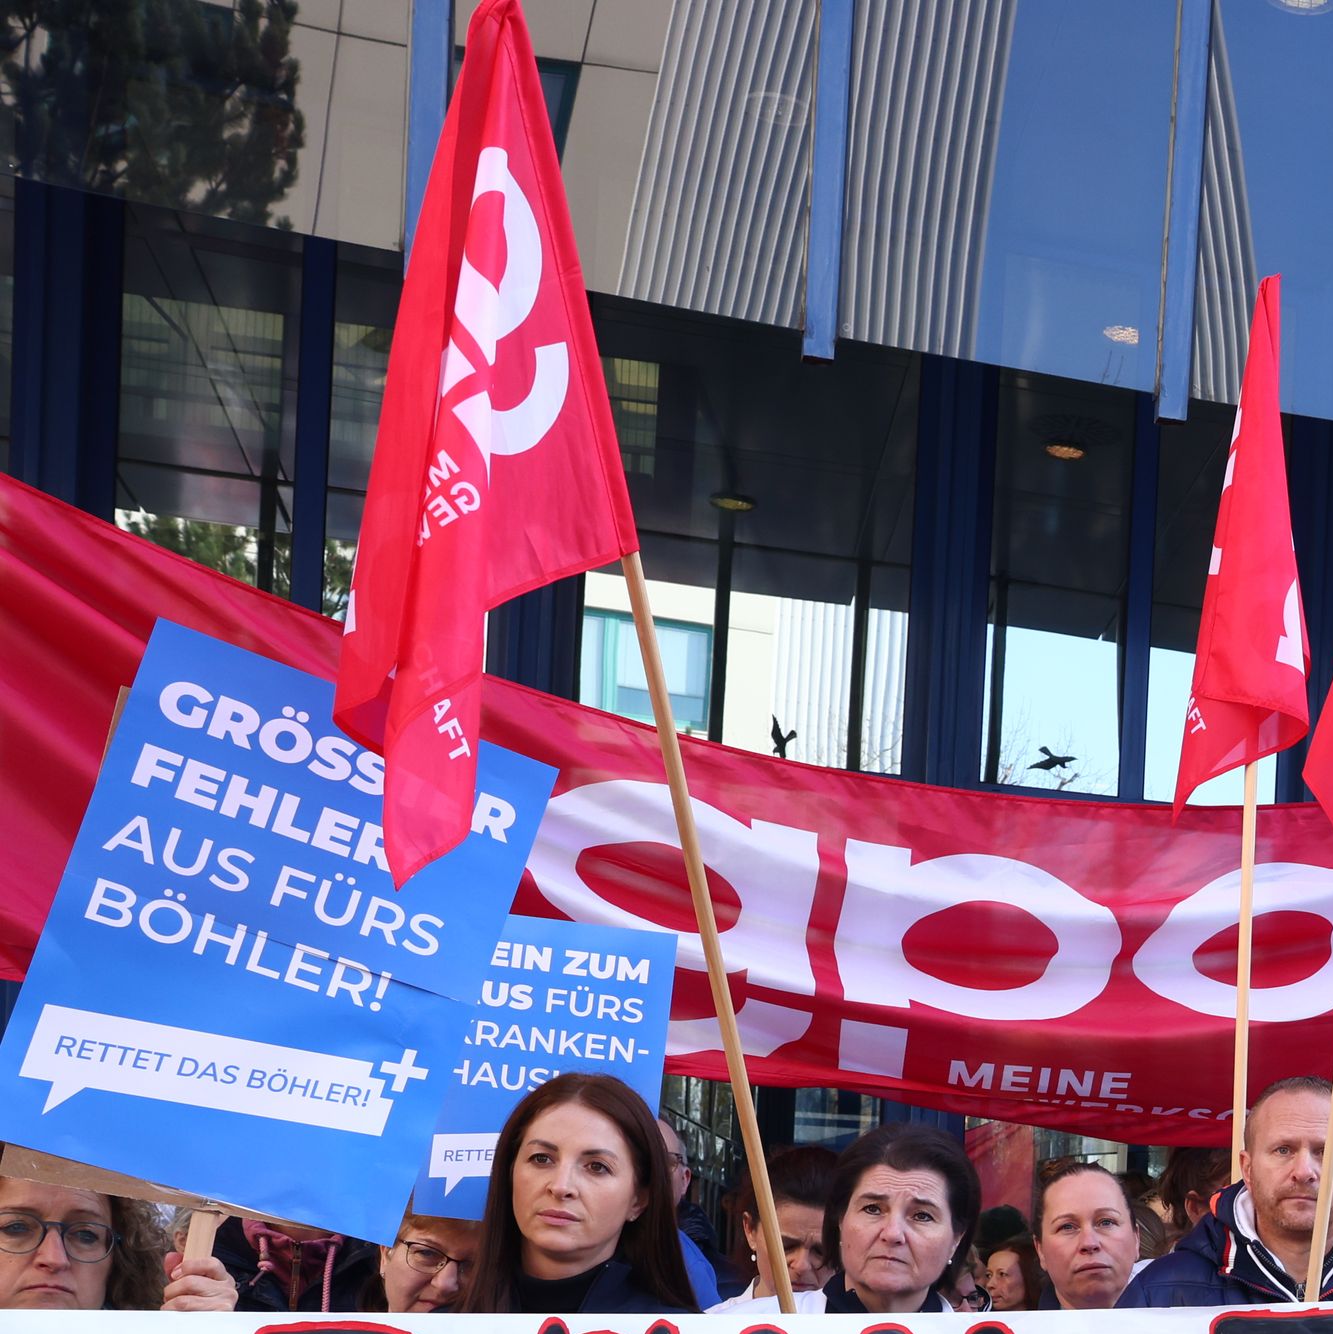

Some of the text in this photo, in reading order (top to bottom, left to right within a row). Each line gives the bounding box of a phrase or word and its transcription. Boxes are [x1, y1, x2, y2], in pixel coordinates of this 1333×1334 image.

[103, 814, 445, 957] AUS FÜRS
[84, 878, 392, 1012] BÖHLER!
[490, 941, 650, 984] EIN ZUM
[477, 980, 644, 1024] US FÜRS
[54, 1034, 371, 1108] RETTET DAS BÖHLER!
[947, 1060, 1132, 1100] MEINE
[443, 1149, 494, 1163] RETTE
